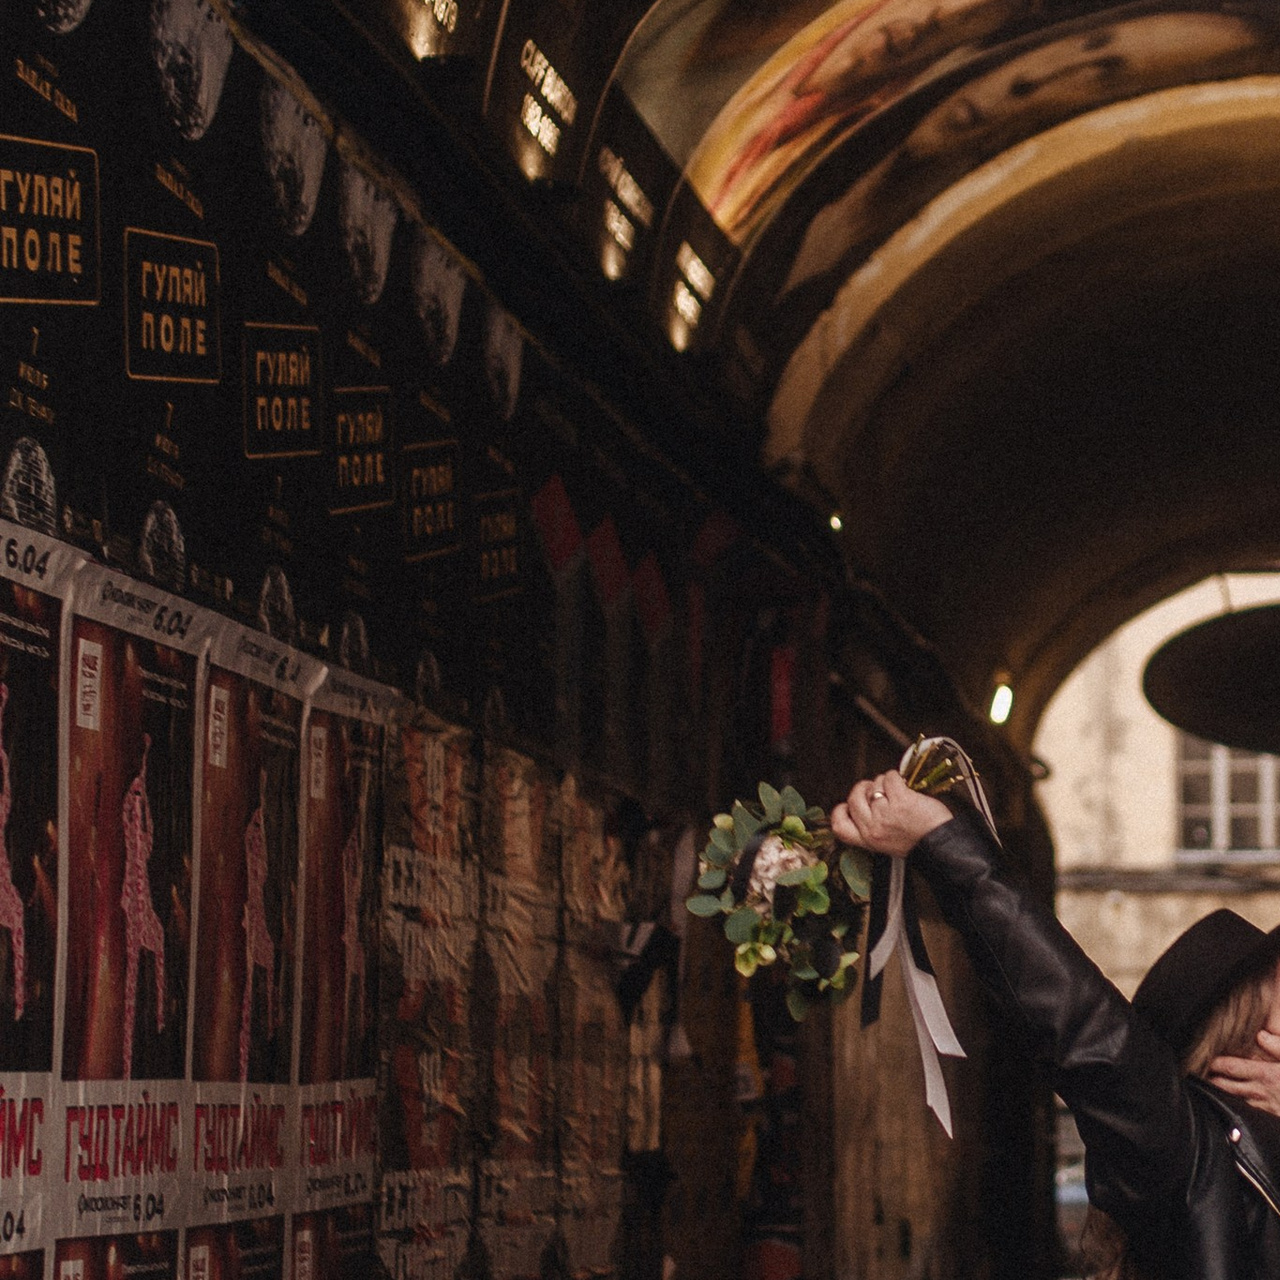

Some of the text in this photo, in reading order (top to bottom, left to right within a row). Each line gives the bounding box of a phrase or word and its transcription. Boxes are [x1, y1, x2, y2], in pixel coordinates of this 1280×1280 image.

[0, 169, 82, 221] ГУЛЯЙ
[0, 227, 82, 274] ПОЛЕ
[141, 261, 207, 308] ГУЛЯЙ
[141, 311, 208, 356] ПОЛЕ
[256, 344, 311, 386] ГУЛЯЙ
[256, 396, 312, 431] ПОЛЕ
[5, 537, 50, 580] 6.04
[65, 1090, 179, 1183] ГУДТАЙМС
